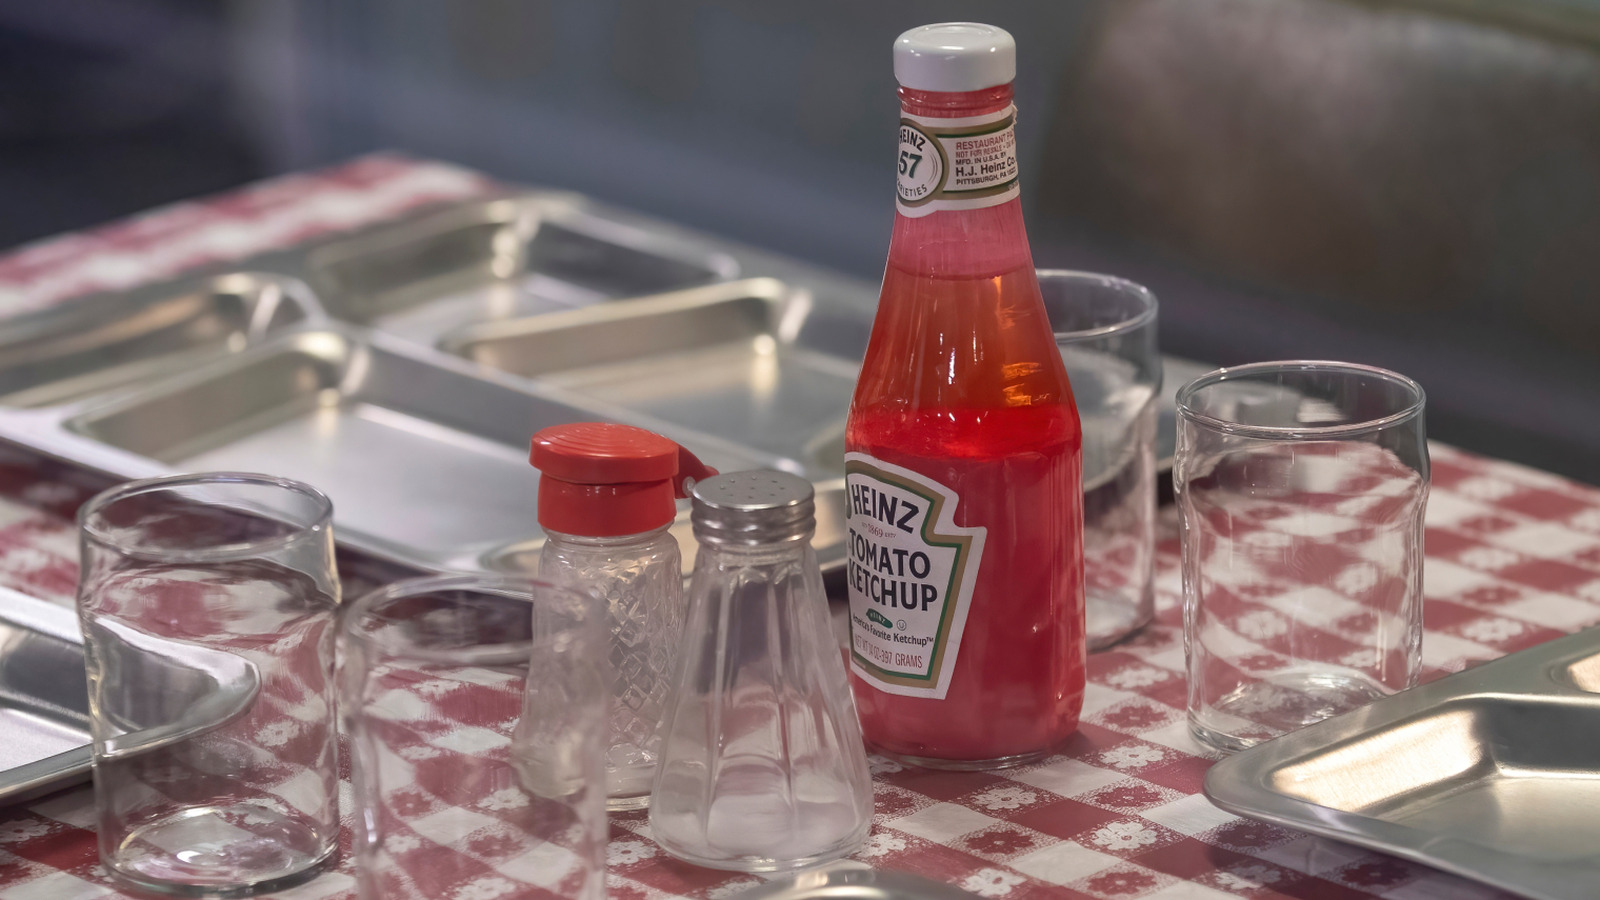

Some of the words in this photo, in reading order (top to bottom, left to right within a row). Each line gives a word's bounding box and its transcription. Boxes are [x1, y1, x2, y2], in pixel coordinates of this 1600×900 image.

[956, 134, 1006, 150] RESTAURANT
[970, 149, 982, 157] FOR
[899, 150, 923, 179] 57
[956, 166, 977, 177] H.J.
[981, 161, 1006, 175] Heinz
[1000, 171, 1007, 179] PA
[851, 484, 919, 534] HEINZ
[868, 523, 884, 537] 1869
[849, 527, 931, 579] TOMATO
[848, 558, 938, 612] KETCHUP
[870, 625, 891, 641] Favorite
[895, 652, 923, 669] GRAMS
